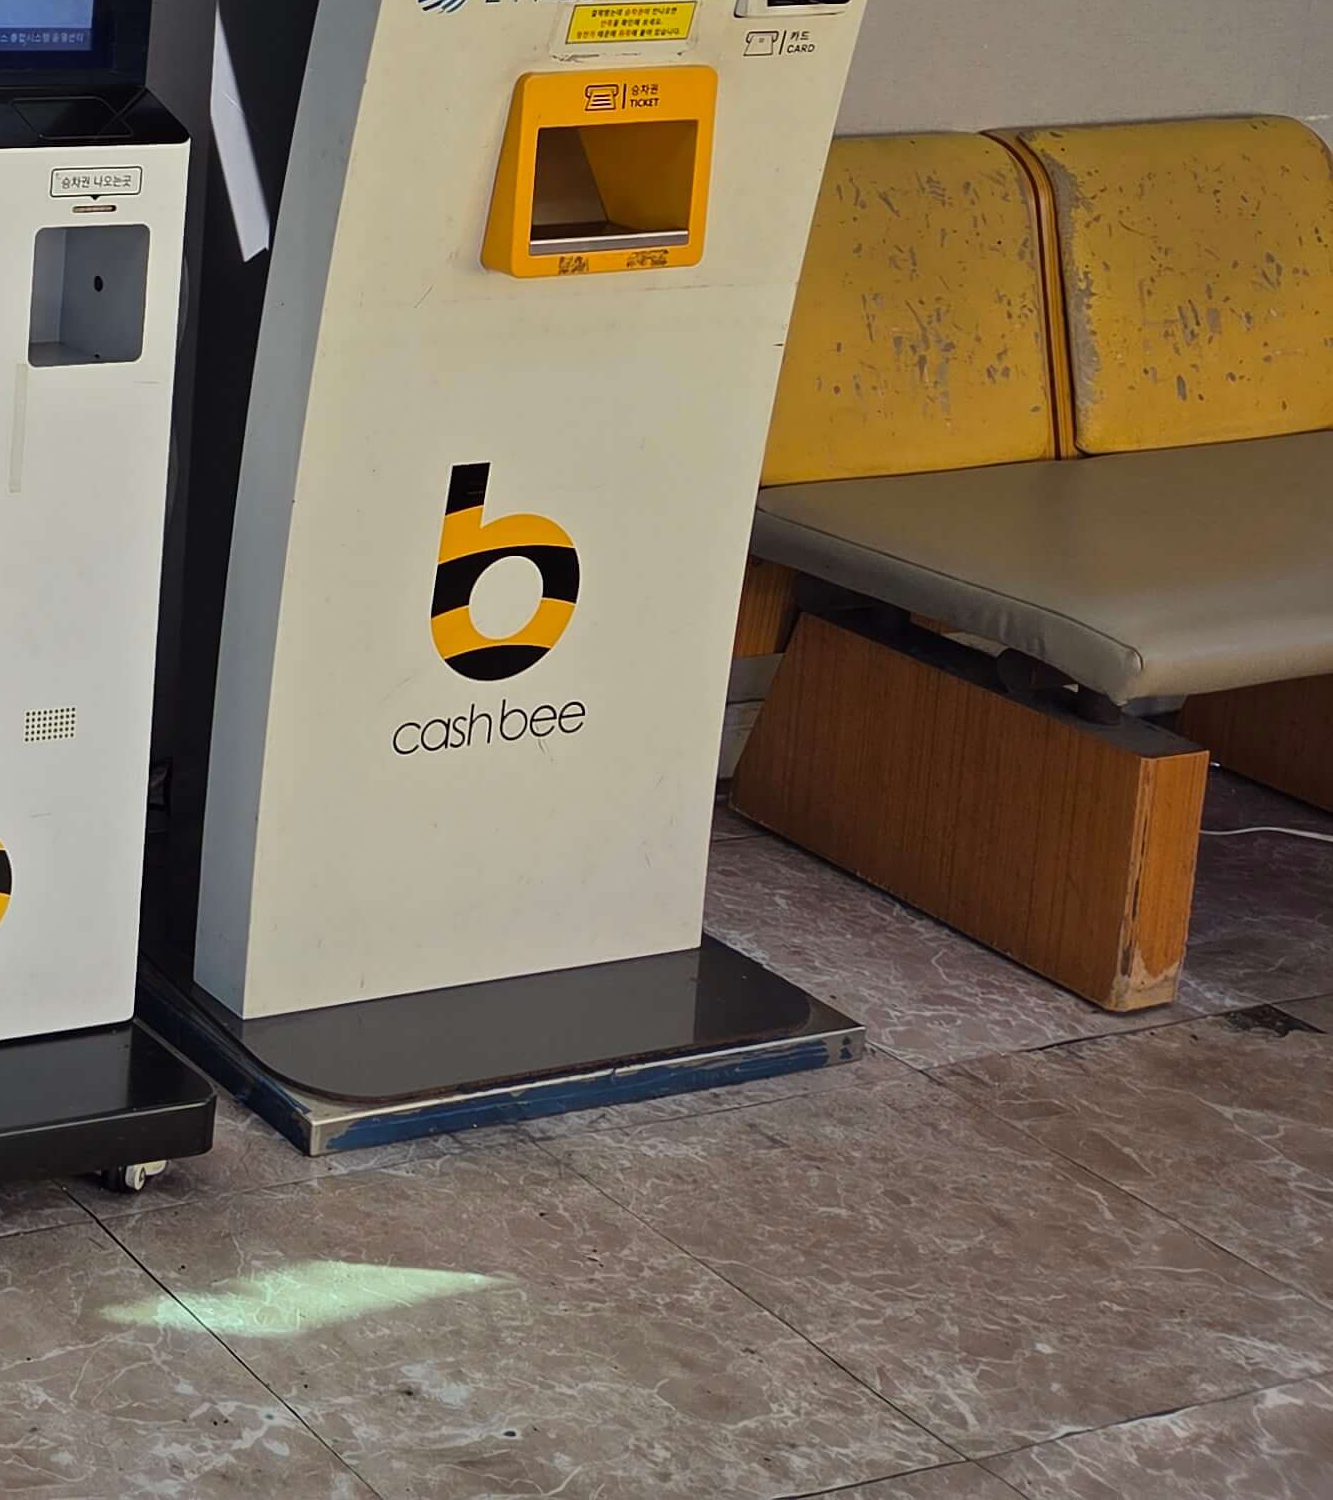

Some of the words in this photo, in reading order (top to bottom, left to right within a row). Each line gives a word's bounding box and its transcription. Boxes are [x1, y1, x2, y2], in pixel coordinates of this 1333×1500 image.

[790, 30, 810, 41] 카드
[787, 43, 815, 54] CARD
[630, 97, 661, 109] TICKET
[60, 176, 90, 190] 승차권
[93, 174, 132, 188] 나오는곳
